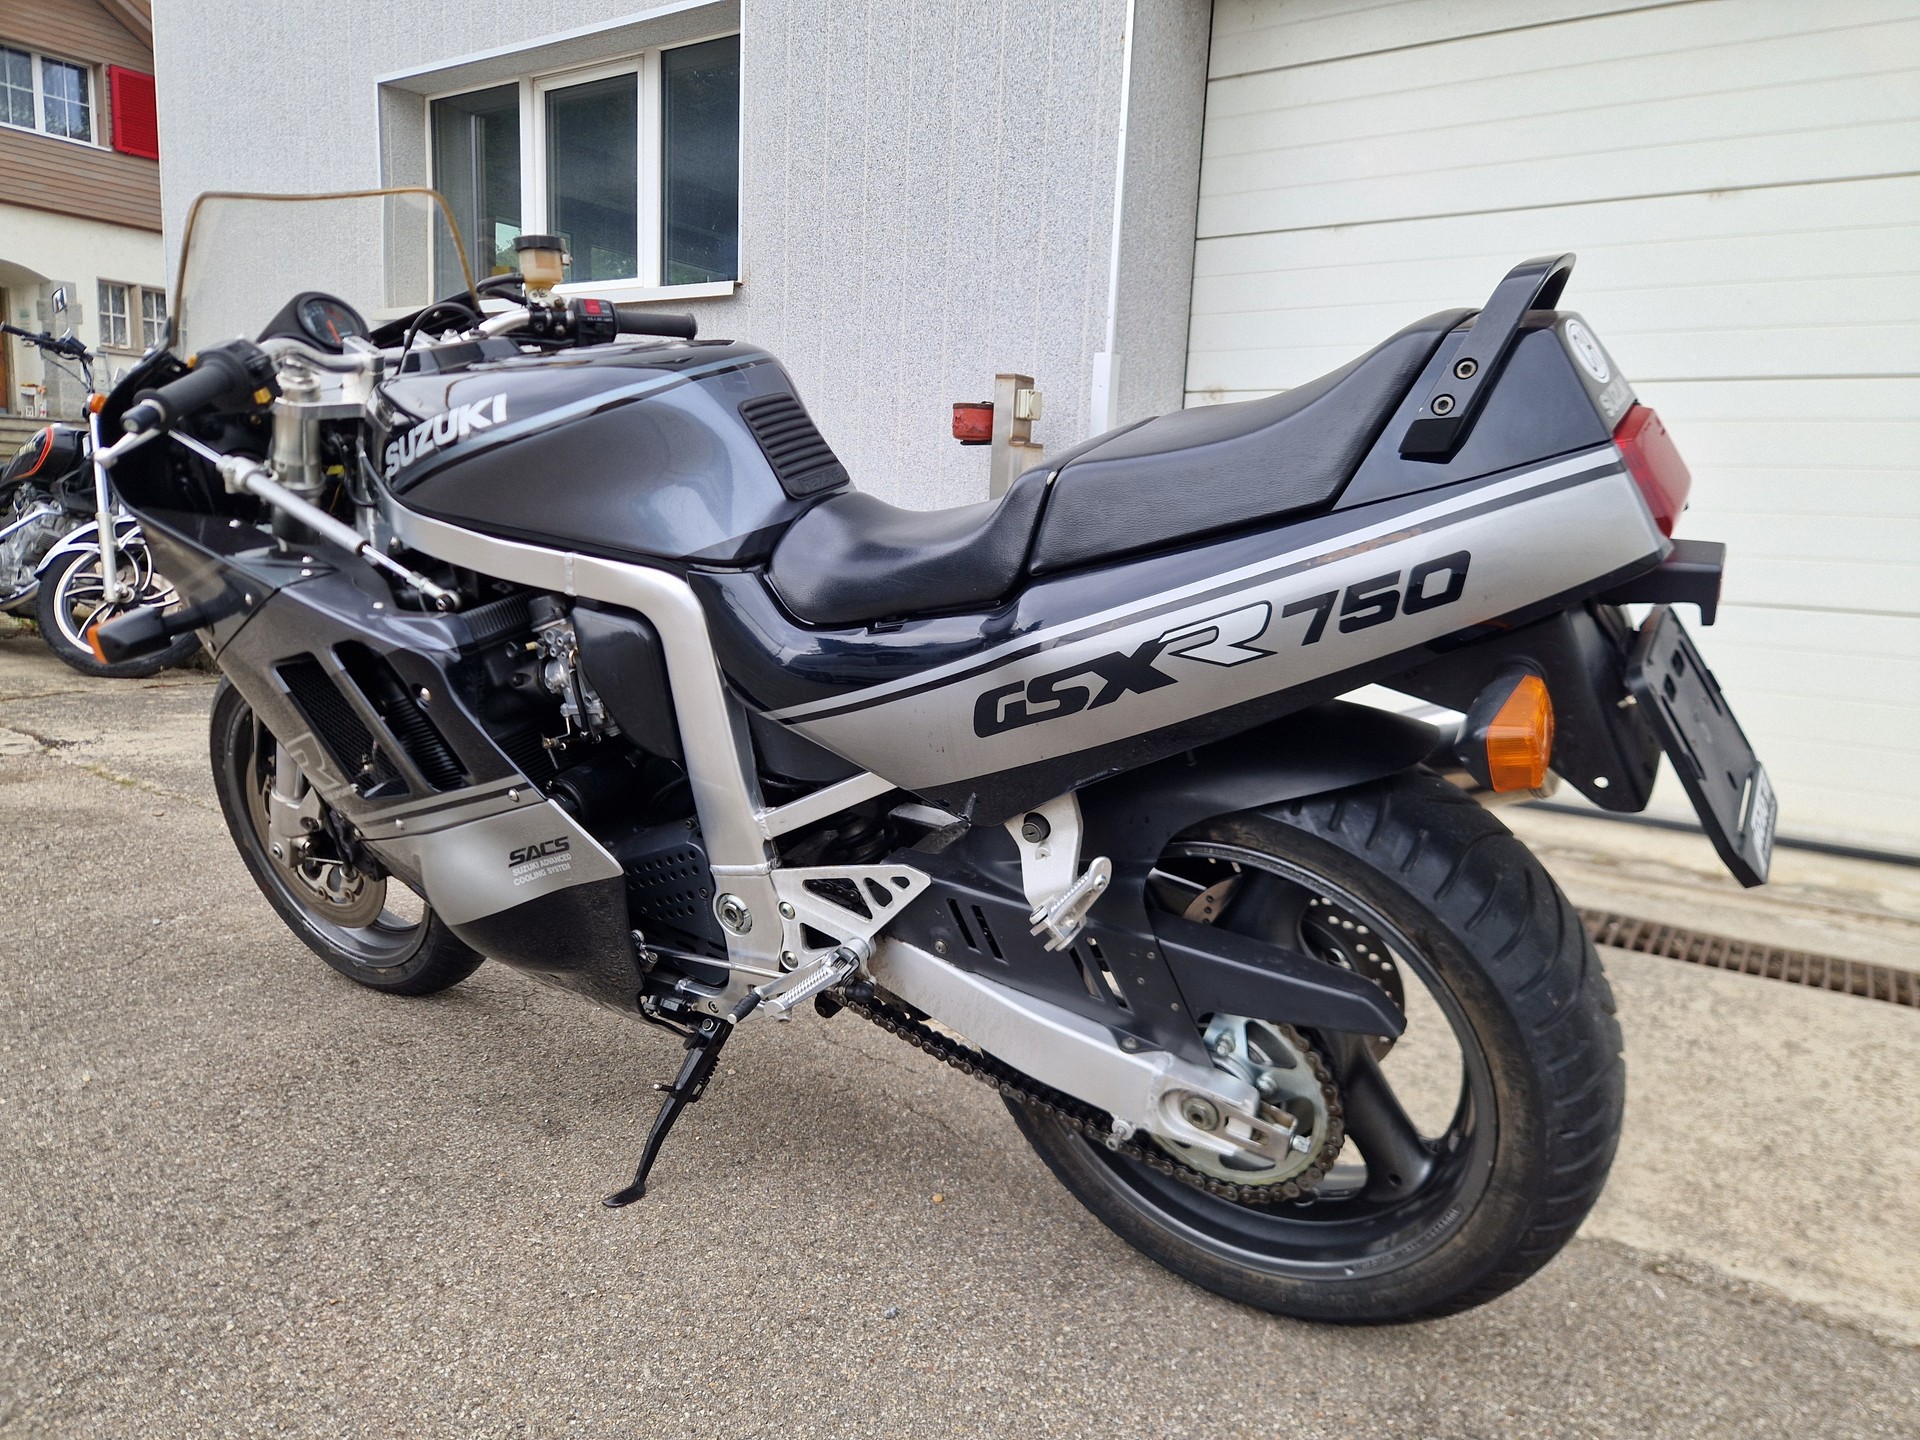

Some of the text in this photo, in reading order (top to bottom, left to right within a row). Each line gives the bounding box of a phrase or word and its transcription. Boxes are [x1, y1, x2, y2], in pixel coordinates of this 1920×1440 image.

[384, 392, 507, 481] SUZUKI
[1281, 550, 1471, 646] 750
[508, 836, 570, 868] SACS
[512, 853, 572, 877] SUZUKI ADVANCED
[513, 862, 571, 886] COOLING SYSTEM
